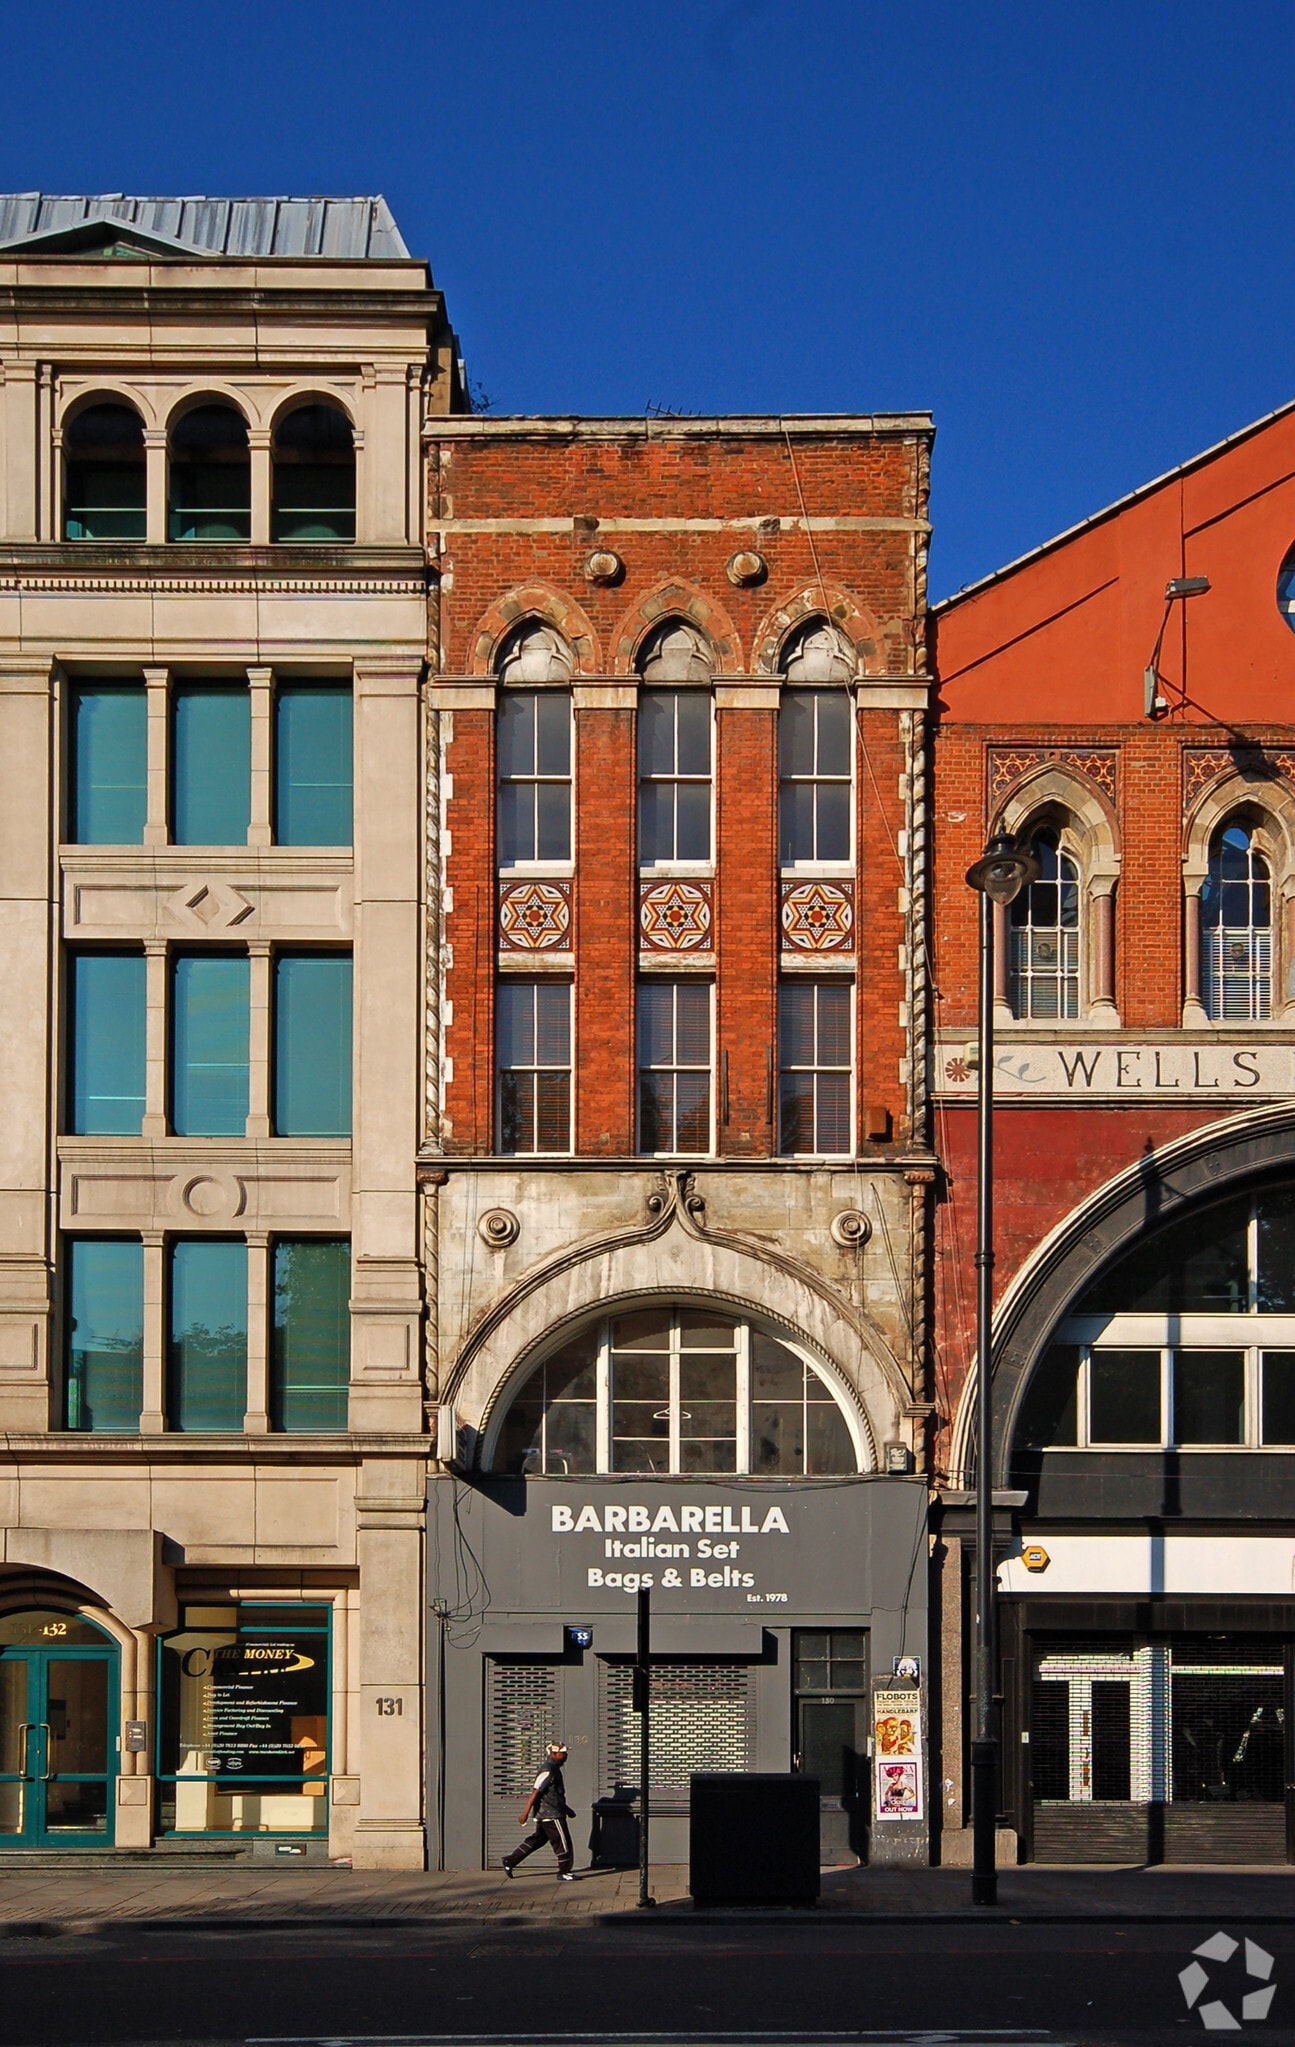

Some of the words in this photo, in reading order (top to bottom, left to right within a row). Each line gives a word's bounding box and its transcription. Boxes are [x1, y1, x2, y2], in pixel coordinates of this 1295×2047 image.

[1057, 1051, 1260, 1088] WELLS
[551, 1505, 790, 1532] BARBARELLA
[604, 1537, 690, 1559] Italian
[696, 1537, 740, 1559] Set
[587, 1568, 654, 1594] Bags
[661, 1568, 684, 1588] &
[689, 1566, 755, 1588] Belts
[747, 1594, 763, 1603] Est.
[765, 1594, 789, 1603] 1978
[244, 1649, 294, 1659] MONEY
[376, 1697, 403, 1716] 131
